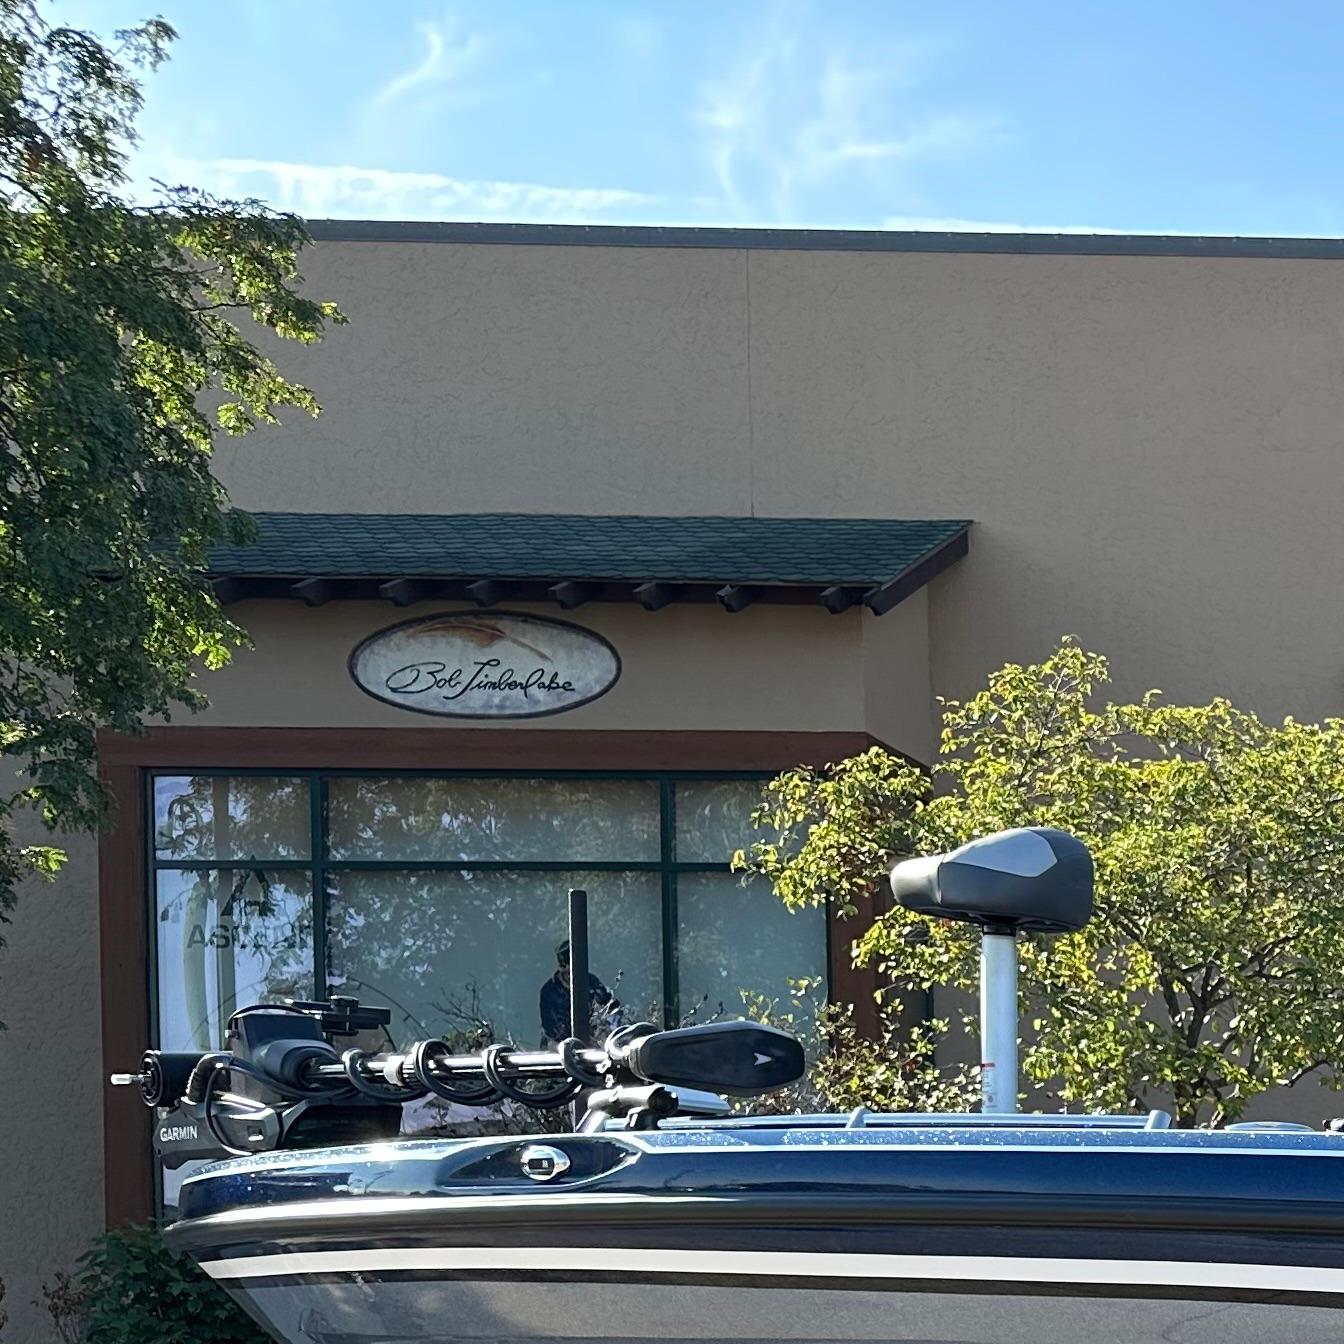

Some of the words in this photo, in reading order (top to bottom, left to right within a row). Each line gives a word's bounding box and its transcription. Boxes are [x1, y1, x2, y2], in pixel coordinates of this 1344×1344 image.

[386, 661, 461, 694] Bob
[443, 658, 576, 700] Timberlake
[159, 1125, 198, 1142] GARMIN
